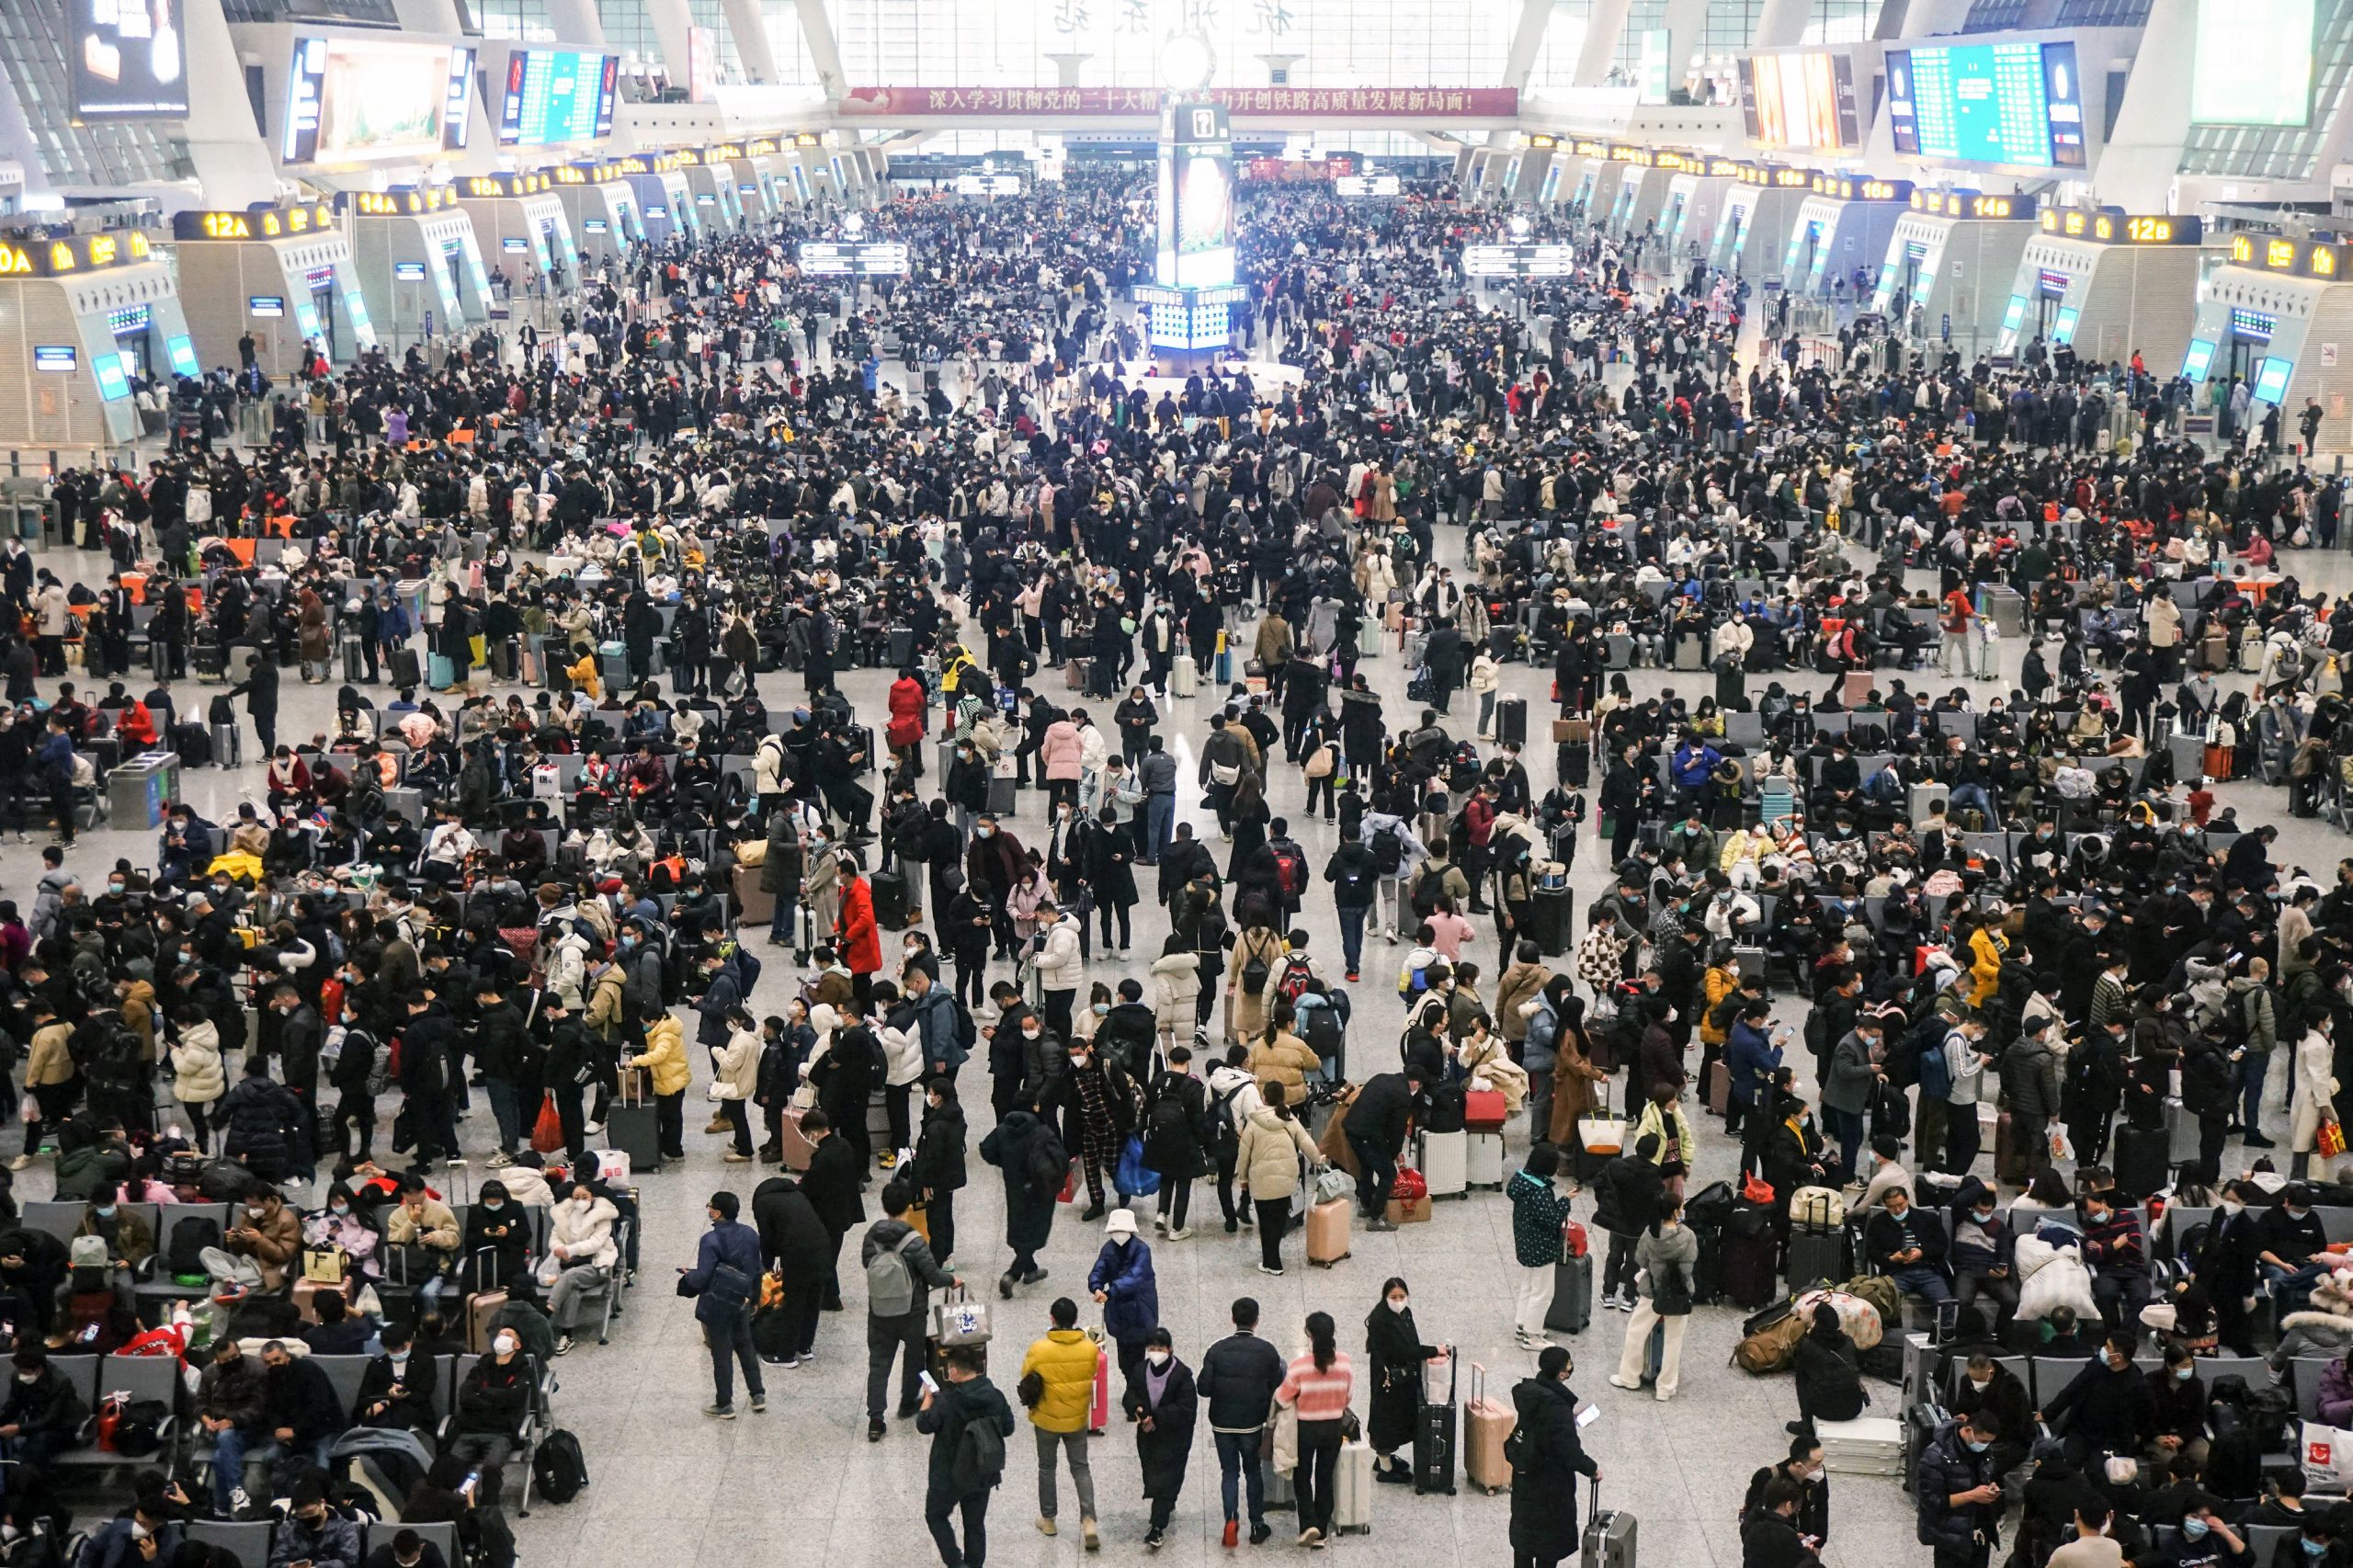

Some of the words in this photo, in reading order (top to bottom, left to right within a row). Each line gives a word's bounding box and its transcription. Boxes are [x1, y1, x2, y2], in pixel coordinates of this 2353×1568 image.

[929, 90, 1161, 110] 深入学习贯彻党的二十大精
[622, 158, 647, 173] 20A
[359, 193, 397, 213] 14A
[1973, 197, 2009, 216] 14B
[205, 212, 250, 237] 12A
[2128, 217, 2171, 240] 12B
